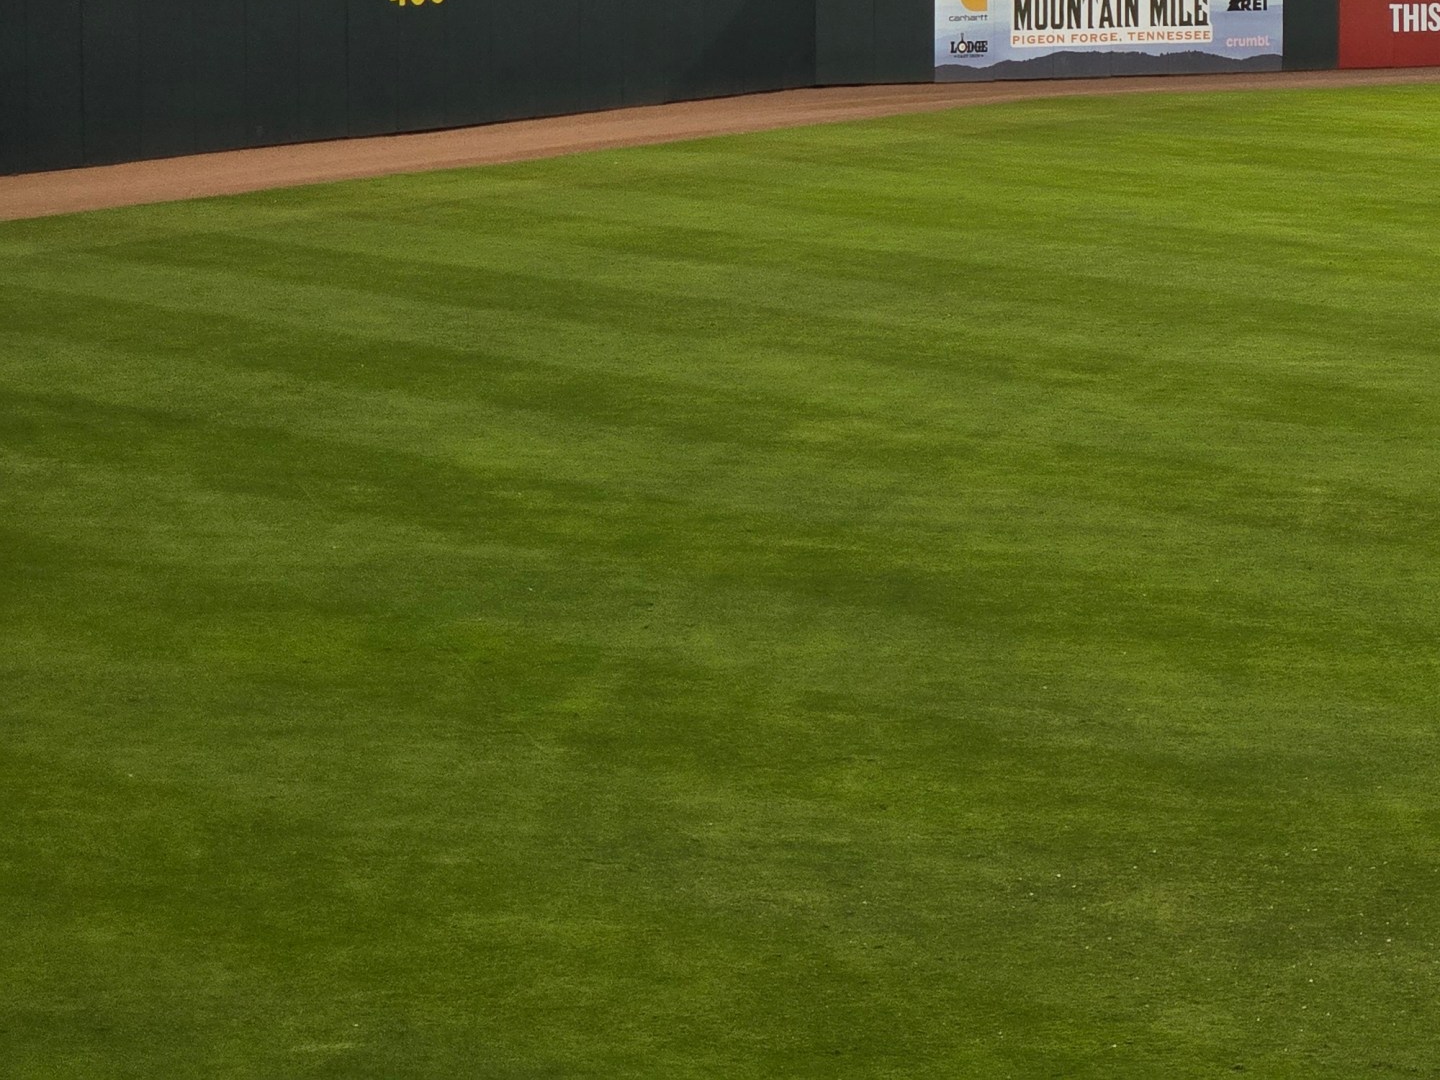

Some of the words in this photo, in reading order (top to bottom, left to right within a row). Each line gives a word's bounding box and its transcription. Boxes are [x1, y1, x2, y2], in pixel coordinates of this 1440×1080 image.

[948, 14, 988, 22] carhartt
[1012, 34, 1065, 45] PIGEON
[1070, 32, 1122, 44] FORGE,
[1127, 30, 1211, 41] TENNESSEE
[1226, 35, 1270, 47] crumbl
[950, 37, 988, 54] LODGE
